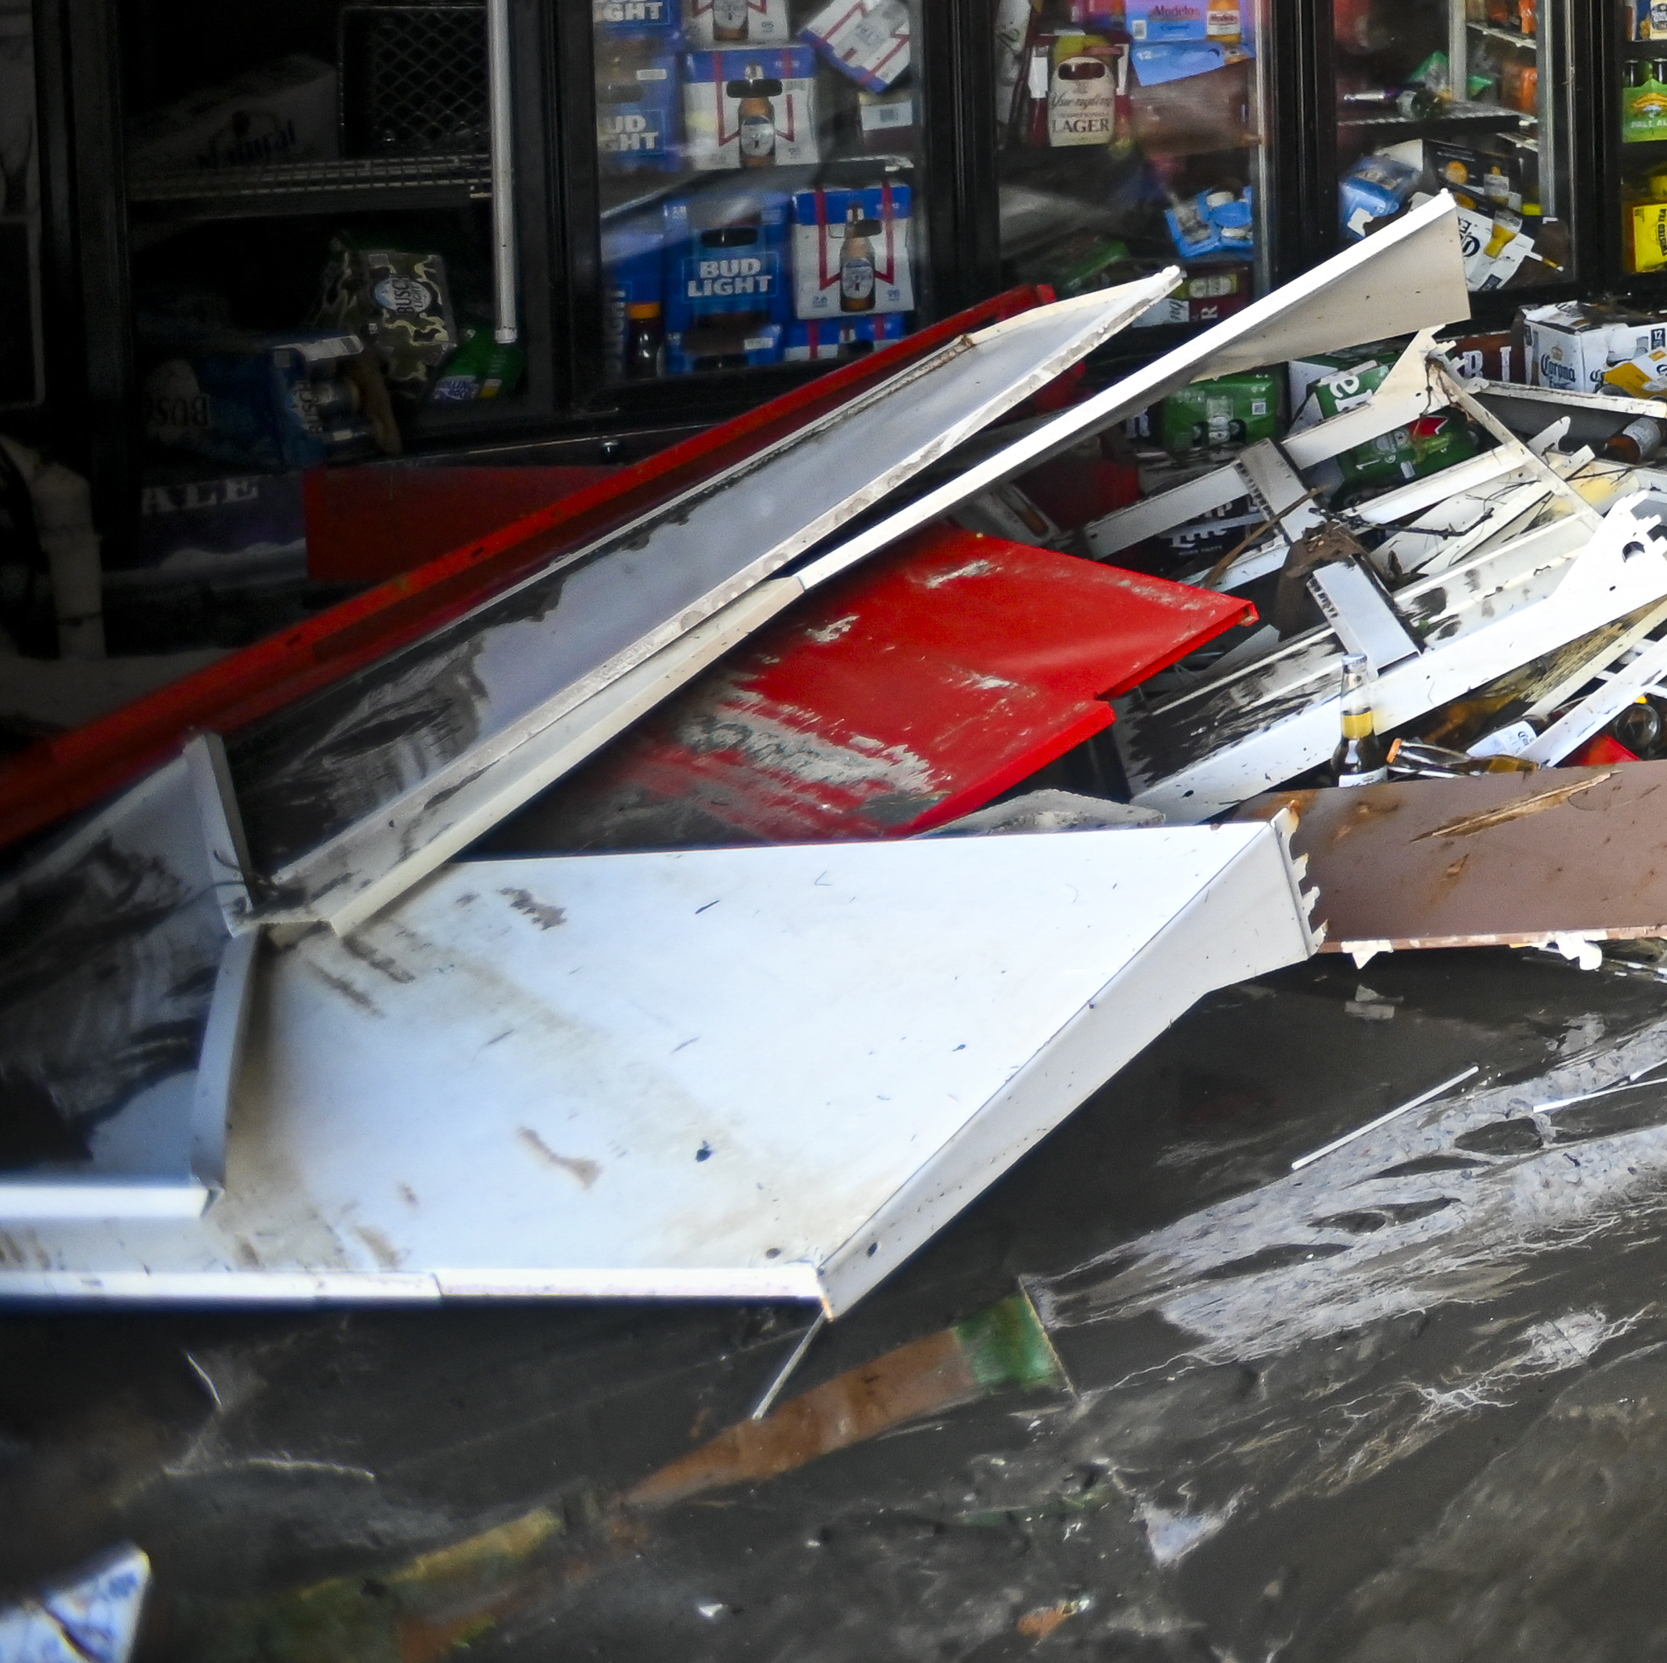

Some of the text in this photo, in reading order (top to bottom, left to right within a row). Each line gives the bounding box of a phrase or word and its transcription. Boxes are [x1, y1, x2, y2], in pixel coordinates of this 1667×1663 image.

[602, 114, 647, 134] UD
[1051, 119, 1110, 133] LAGER
[699, 258, 762, 279] BUD
[687, 275, 773, 298] LIGHT
[1652, 329, 1664, 340] 12
[1540, 353, 1576, 382] Corona
